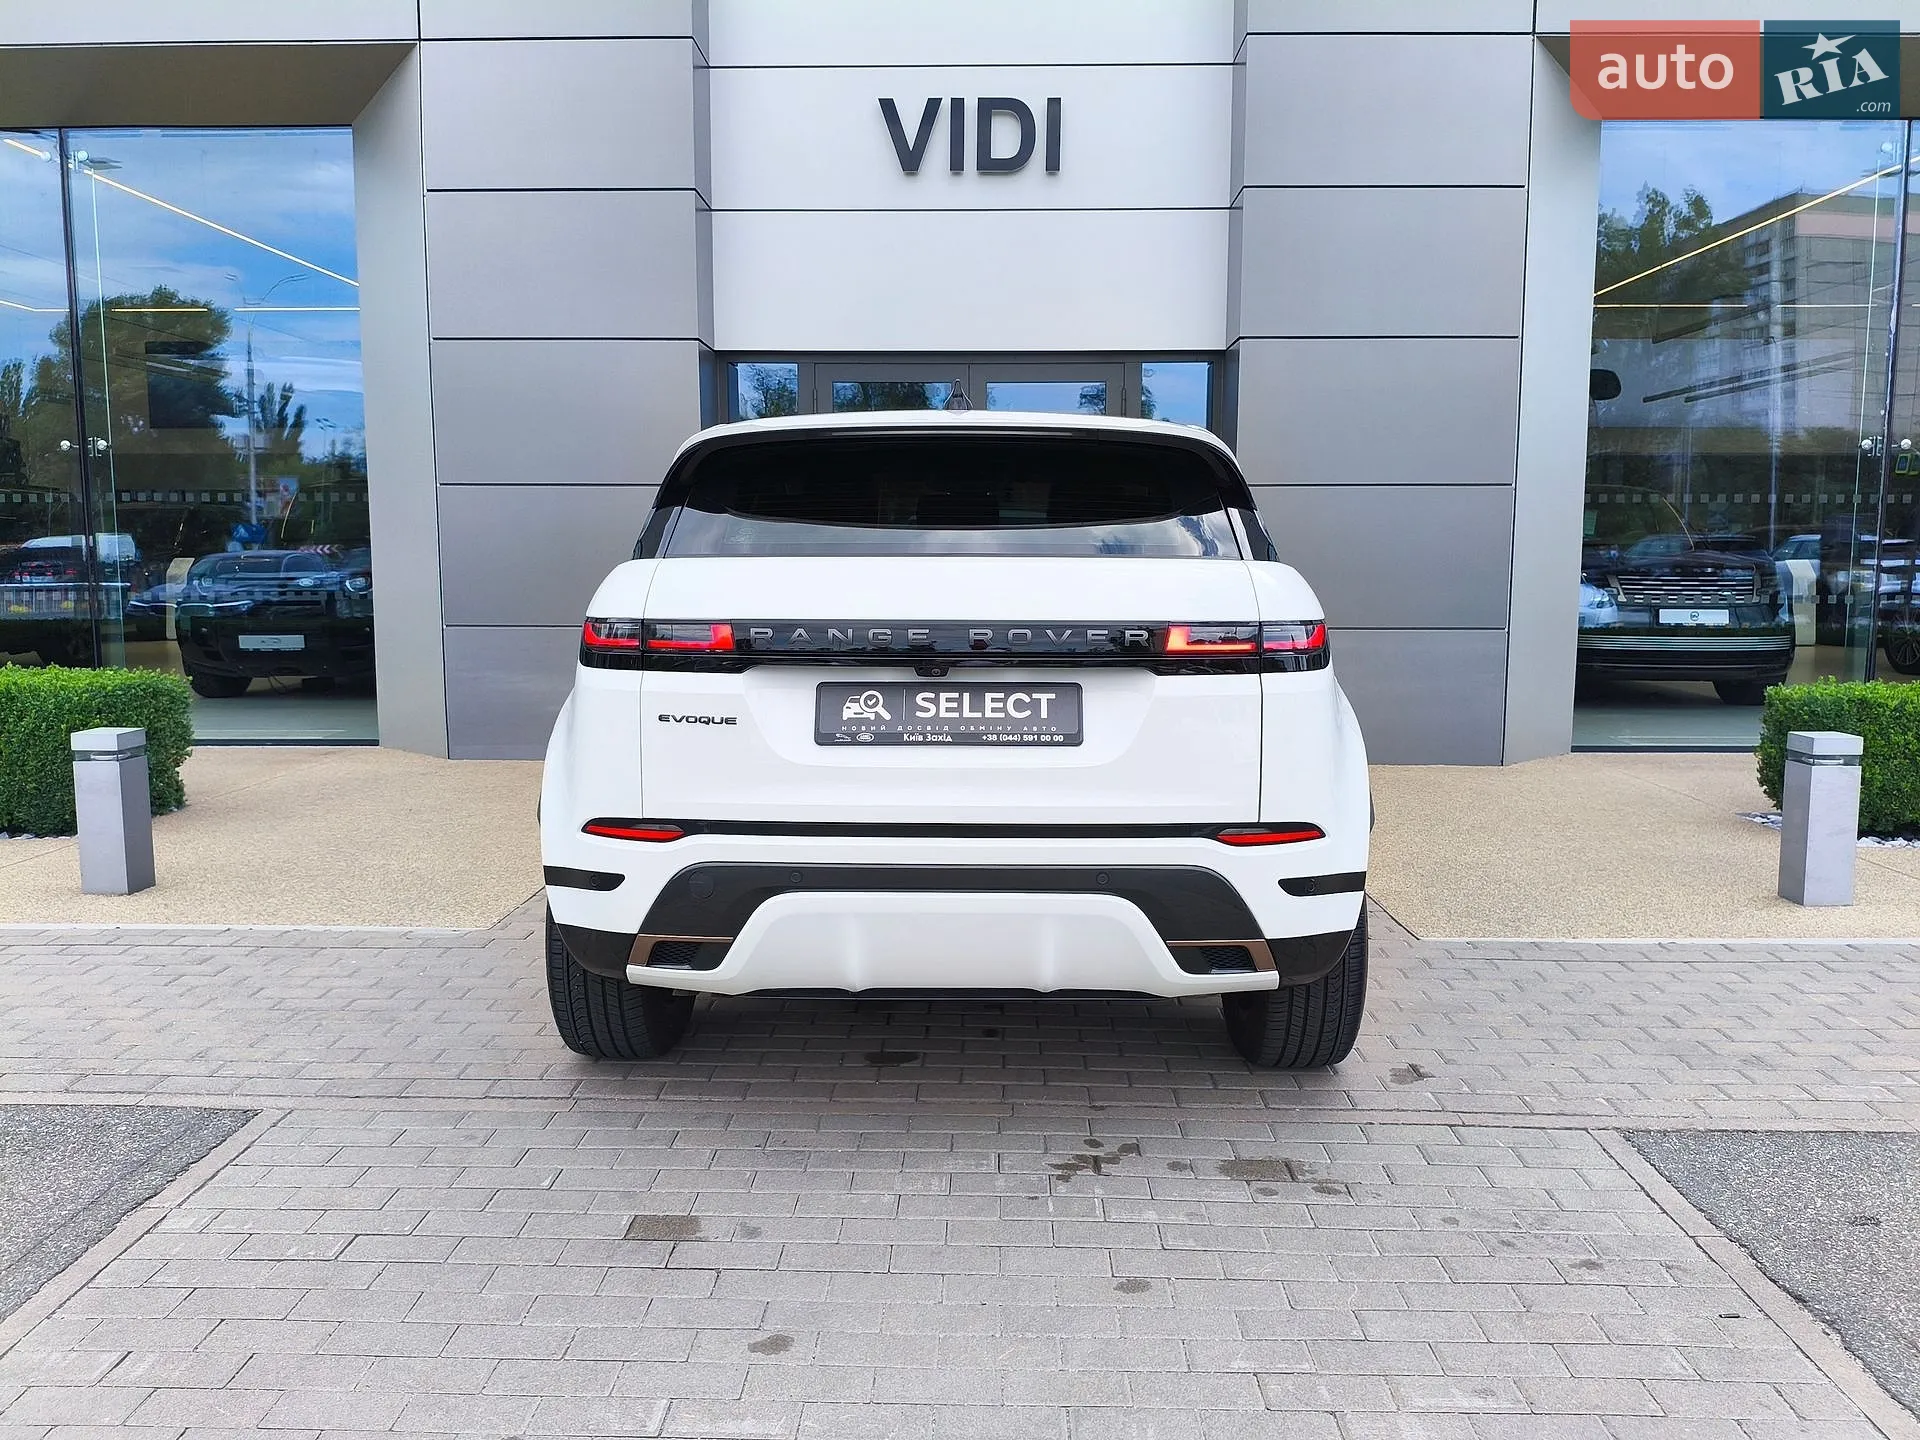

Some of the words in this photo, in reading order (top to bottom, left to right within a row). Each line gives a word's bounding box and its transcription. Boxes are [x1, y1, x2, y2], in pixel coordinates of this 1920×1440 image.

[878, 97, 1061, 173] VIDI
[750, 627, 931, 648] RANGE
[969, 628, 1149, 647] ROVER
[915, 692, 1056, 719] SELECT
[658, 714, 738, 725] EVOQUE
[903, 732, 923, 741] Київ
[925, 733, 953, 742] Захід
[999, 734, 1021, 742] (044)
